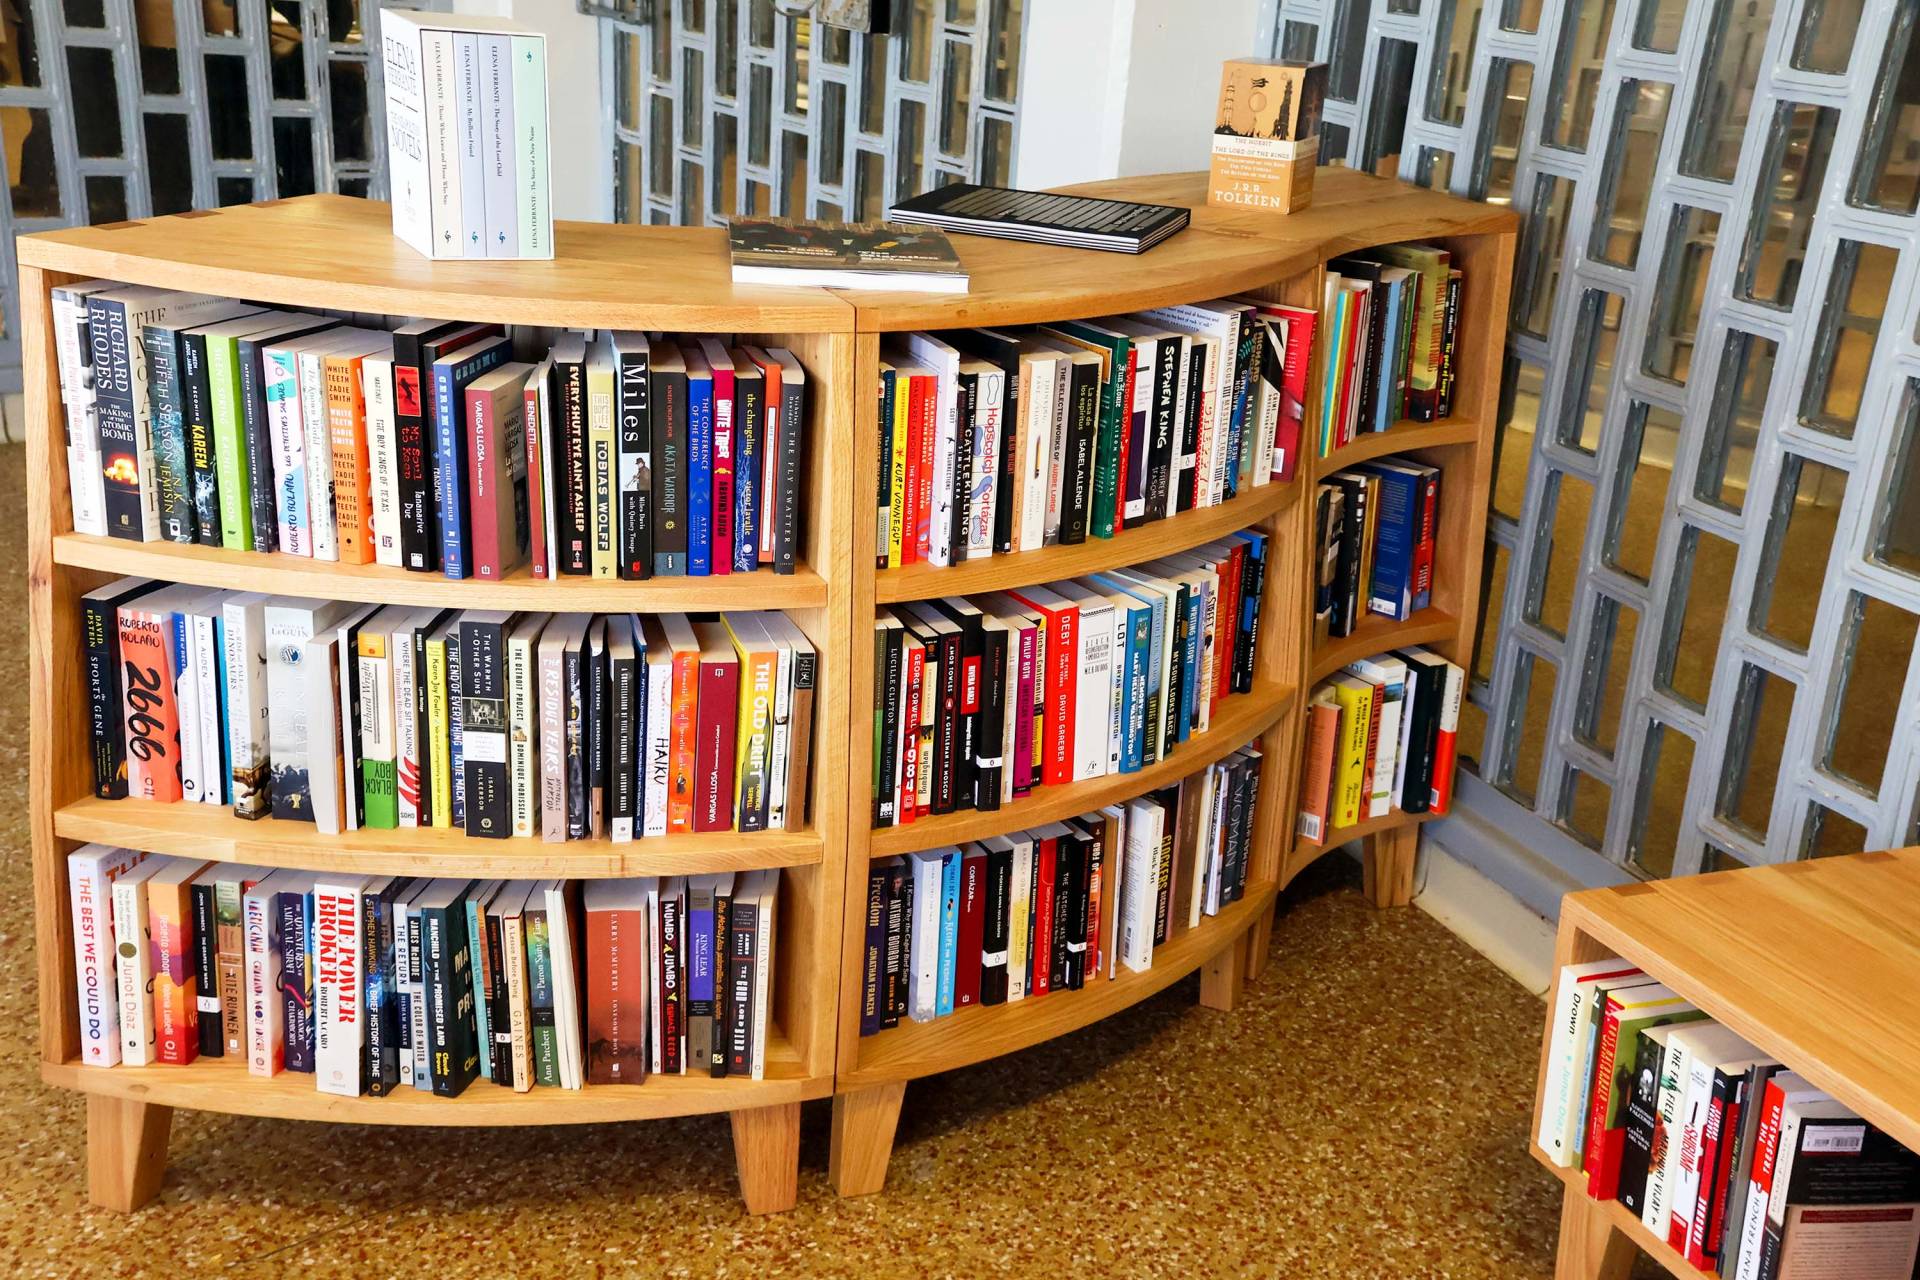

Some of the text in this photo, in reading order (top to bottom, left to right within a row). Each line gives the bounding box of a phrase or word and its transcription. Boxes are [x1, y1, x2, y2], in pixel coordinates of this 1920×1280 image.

[1215, 191, 1280, 208] TOLKIEN
[91, 308, 113, 391] RHODES
[109, 310, 128, 392] RICHARD
[327, 366, 349, 374] WHITE
[1442, 354, 1450, 369] gods
[329, 385, 350, 393] ZADIE
[329, 394, 351, 402] SMITH
[569, 366, 580, 402] EVERY
[622, 362, 646, 442] Miles
[1157, 345, 1175, 449] STEPHEN KING
[99, 407, 132, 418] MAKING
[101, 421, 132, 432] ATOMIC
[158, 402, 175, 463] SEASON
[330, 408, 352, 417] WHITE
[474, 400, 485, 462] VARGAS LLOSA
[571, 405, 581, 436] SHUT
[692, 405, 698, 416] OF
[102, 428, 134, 442] BOMB
[191, 424, 207, 469] KAREEM
[333, 452, 355, 460] WHITE
[573, 438, 582, 458] EYE
[334, 461, 355, 469] TEETH
[335, 471, 356, 479] ZADIE
[335, 480, 357, 488] SMITH
[574, 460, 584, 490] AIN'T
[595, 442, 608, 496] TOBIAS
[978, 408, 998, 536] Hopscotch Cortázar
[1075, 439, 1087, 510] ISABEL ALLENDE
[159, 464, 175, 514] JEMISIN
[336, 495, 357, 503] WHITE
[337, 503, 357, 511] TEETH
[404, 502, 414, 519] Due
[890, 462, 904, 545] KURT VONNEGUT
[338, 513, 358, 521] ZADIE
[338, 522, 359, 530] SMITH
[413, 490, 425, 534] Tananarive
[575, 492, 585, 532] ASLEEP
[596, 502, 609, 551] WOLFF
[86, 609, 96, 648] EPSTEIN
[95, 615, 103, 645] DAVID
[119, 617, 160, 633] ROBERTO
[121, 631, 160, 648] BOLAÑO
[1061, 616, 1071, 646] DEBT
[1117, 623, 1126, 648] LOT
[227, 629, 236, 690] DINOSAURS
[401, 641, 409, 666] WHERE
[402, 668, 410, 680] THE
[890, 648, 898, 684] LUCILLE
[1022, 636, 1031, 679] PHILIP ROTH
[91, 656, 103, 737] SPORTS GENE
[125, 660, 166, 762] 2666
[910, 692, 919, 729] ORWELL
[1112, 692, 1122, 739] WASHINGTON
[405, 720, 414, 756] TALKING
[543, 668, 559, 774] RESIDUE YEARS
[749, 662, 770, 777] THE OLD DRIFT
[653, 737, 669, 785] HAIKU
[906, 735, 916, 792] 1984
[1058, 723, 1066, 763] GRAEBER
[365, 777, 392, 796] BLACK
[375, 763, 391, 773] BOY
[454, 754, 464, 801] KATIE MACK
[918, 750, 929, 795] Bombingham
[709, 796, 718, 824] VARGAS
[1224, 784, 1244, 867] WOMAN
[1156, 834, 1172, 893] CLOCKERS
[869, 876, 885, 927] Freedom
[319, 894, 337, 984] BROKER
[366, 899, 376, 975] STEPHEN HAWKING
[397, 925, 407, 985] THE RETURN
[410, 921, 420, 978] JAMES McBRIDE
[664, 902, 676, 989] MUMBO JUMBO
[886, 899, 902, 973] ANTHONY BOURDAIN
[80, 877, 101, 1040] THE BEST WE COULD DO
[338, 894, 356, 1024] THE POWER
[122, 961, 137, 1030] Junot Díaz
[865, 946, 876, 1016] JONATHAN FRANZEN
[226, 973, 238, 1035] KITE RUNNER
[1568, 992, 1581, 1036] Drown
[513, 1010, 523, 1059] GAINES
[544, 1064, 552, 1083] Ann
[1680, 1125, 1699, 1174] SHIBUMI
[1759, 1122, 1767, 1144] THE
[1763, 1105, 1780, 1175] TRESPASSER
[1649, 1135, 1671, 1215] MADHURI VIJAY
